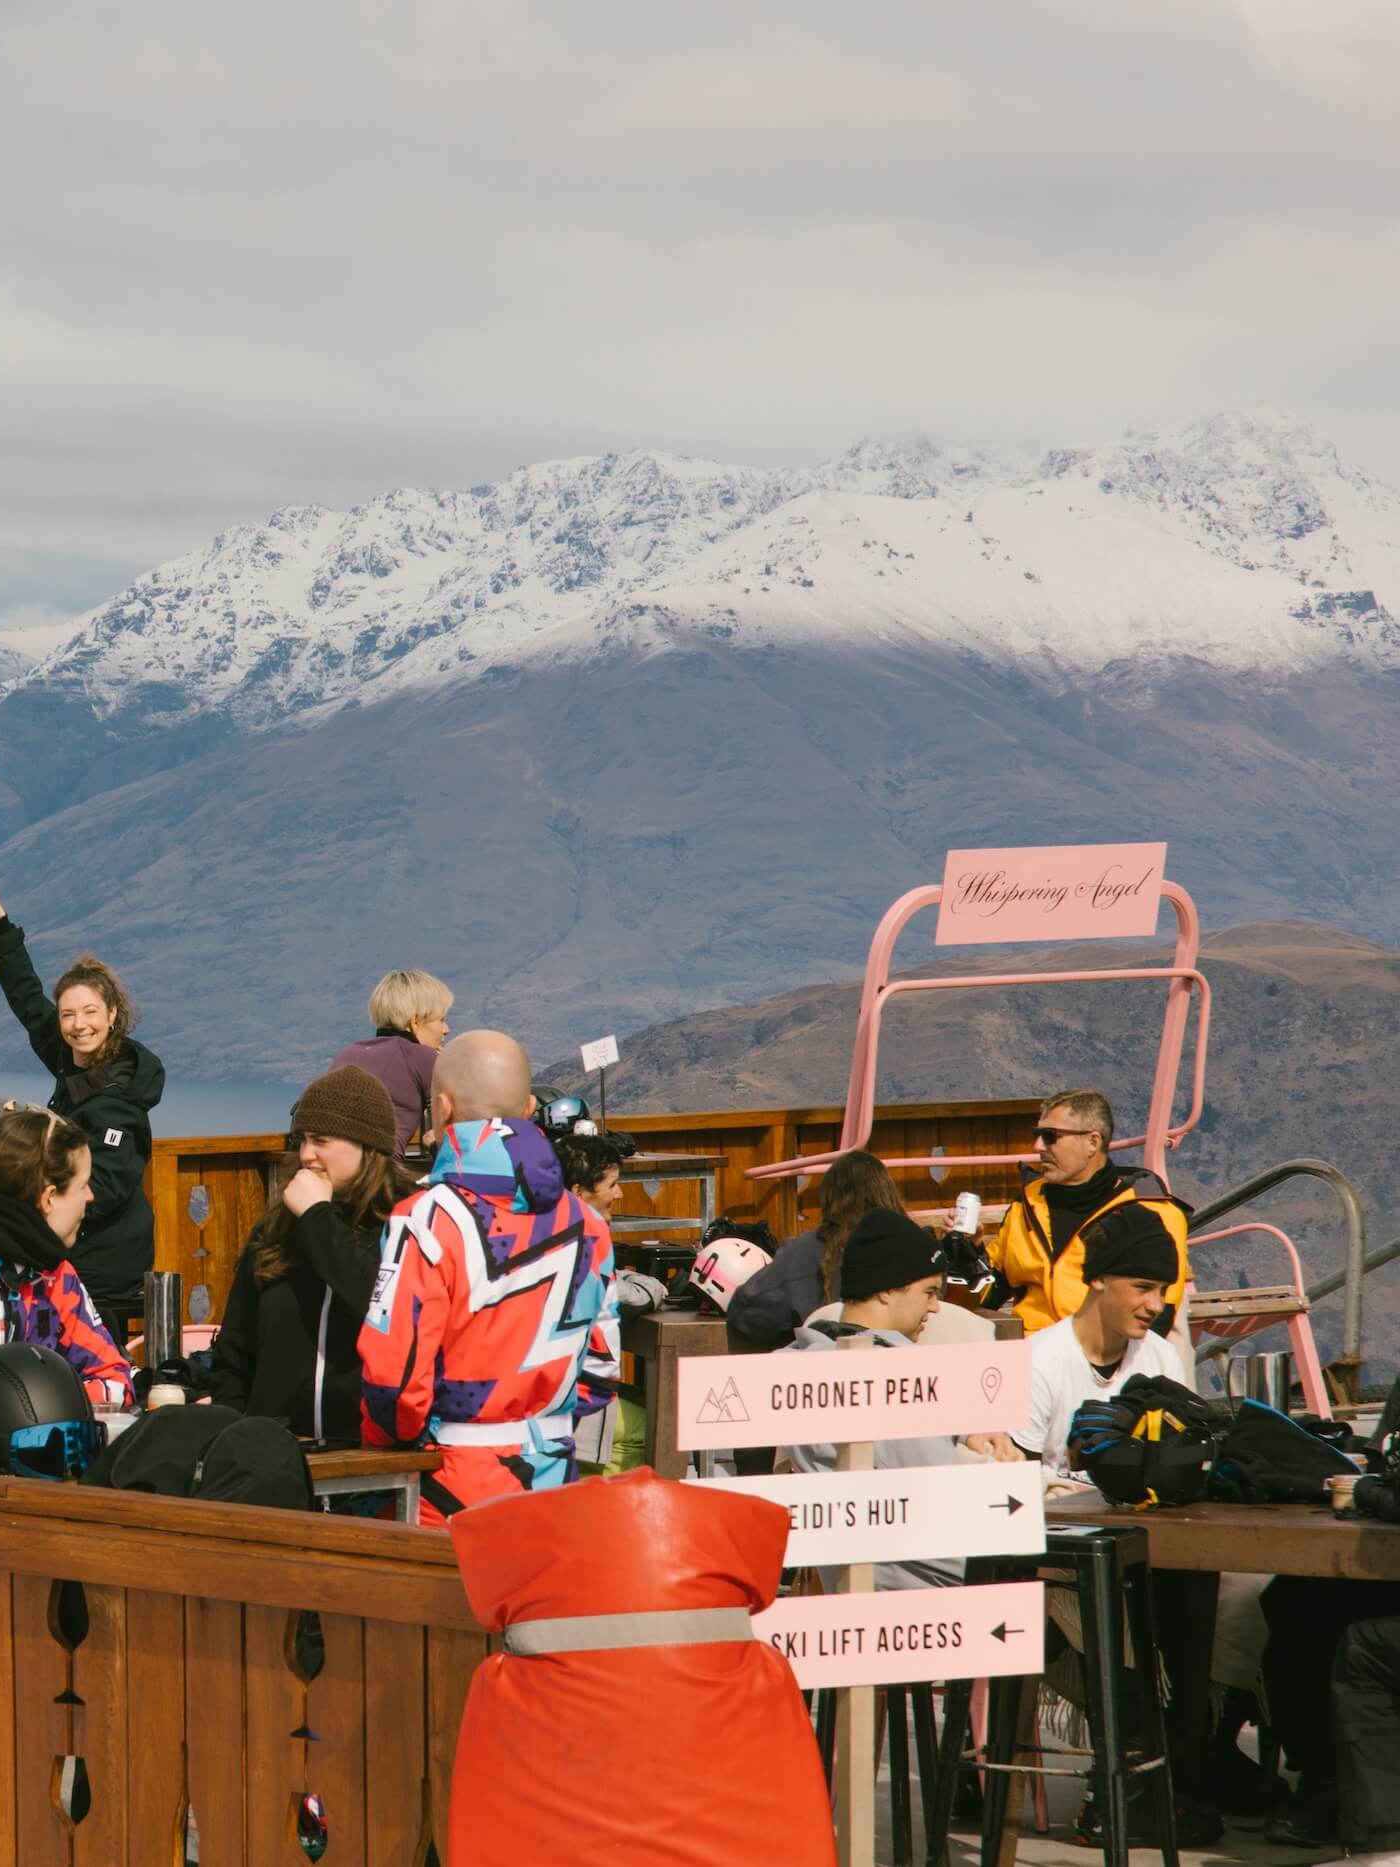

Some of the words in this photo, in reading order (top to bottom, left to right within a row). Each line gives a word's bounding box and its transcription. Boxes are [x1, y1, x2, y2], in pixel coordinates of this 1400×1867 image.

[951, 870, 1069, 917] Whispering
[1074, 865, 1154, 911] Angel
[771, 1380, 874, 1410] CORONET
[886, 1376, 938, 1405] PEAK
[789, 1501, 857, 1530] EIDI'S
[868, 1498, 910, 1526] HUT
[771, 1631, 807, 1658] SKI
[819, 1628, 865, 1656] LIFT
[877, 1621, 963, 1653] ACCESS
